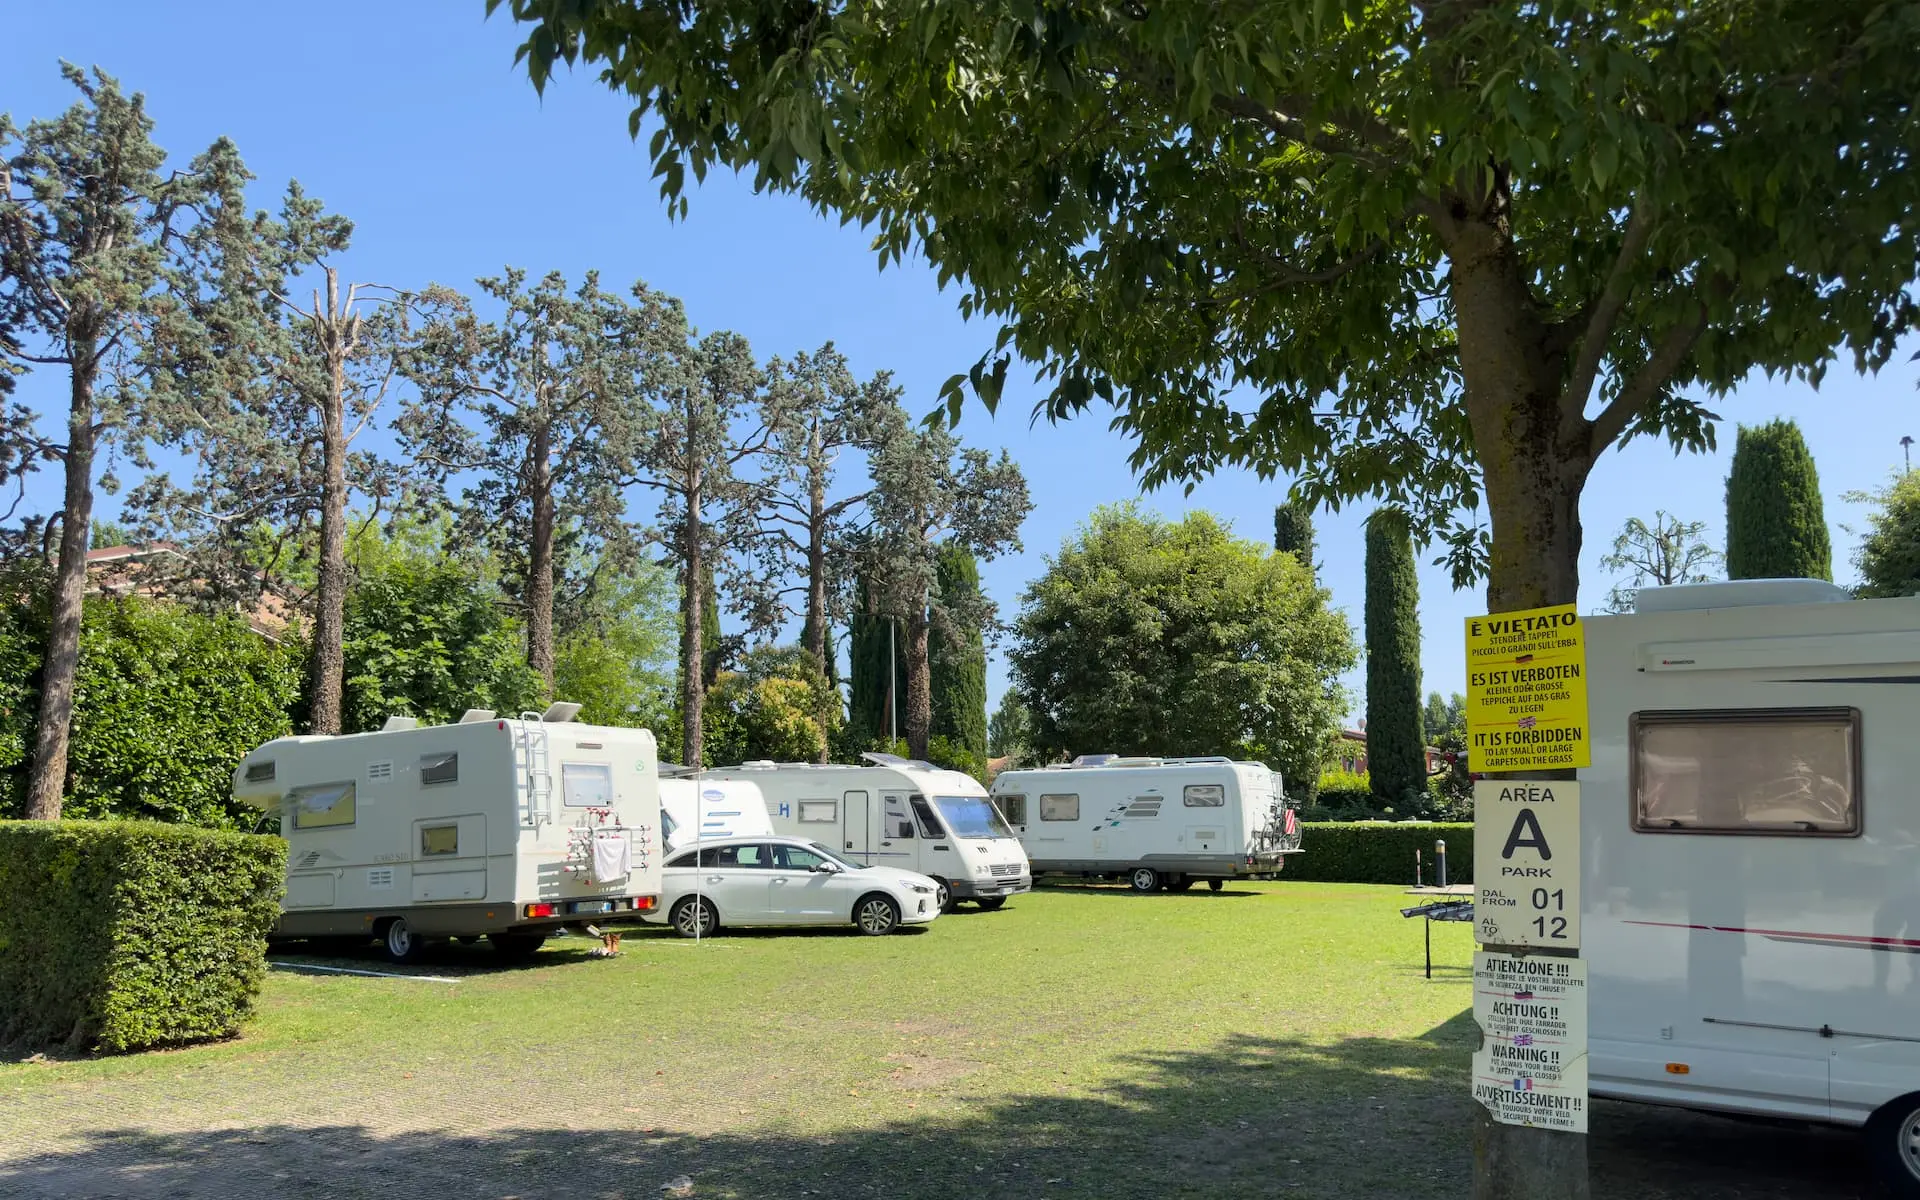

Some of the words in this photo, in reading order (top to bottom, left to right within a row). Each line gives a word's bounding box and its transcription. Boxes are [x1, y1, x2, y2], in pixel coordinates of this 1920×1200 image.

[1488, 612, 1576, 635] VIETATO
[1490, 634, 1526, 645] STENDERE
[1529, 631, 1557, 641] TAPPETI
[1472, 648, 1499, 656] PICCOLI
[1508, 644, 1536, 653] GRANDI
[1538, 639, 1576, 650] SULL'ERBA
[1472, 673, 1486, 686] ES
[1490, 671, 1508, 685] IST
[1512, 664, 1580, 683] VERBOTEN
[1486, 686, 1514, 696] KLEINE
[1514, 684, 1534, 693] ODER
[1536, 682, 1564, 691] GROSSE
[1482, 696, 1515, 706] TEPPICHE
[1518, 694, 1532, 703] AUF
[1534, 693, 1549, 702] DAS
[1550, 691, 1570, 700] GRAS
[1521, 704, 1544, 713] LEGEN
[1475, 734, 1486, 746] IT
[1490, 732, 1502, 745] IS
[1506, 728, 1582, 745] FORBIDDEN
[1485, 748, 1494, 757] TO
[1496, 748, 1508, 756] LAY
[1510, 745, 1535, 755] SMALL
[1549, 744, 1573, 752] LARGE
[1486, 758, 1518, 767] CARPETS
[1520, 757, 1530, 765] ON
[1533, 756, 1547, 764] THE
[1548, 755, 1573, 764] GRASS
[1500, 788, 1554, 802] AREA
[1502, 808, 1552, 861] A
[1502, 867, 1552, 878] PARK
[1482, 898, 1516, 907] FROM
[1532, 888, 1564, 910] 01
[1482, 926, 1498, 934] TO
[1532, 916, 1567, 939] 12
[1557, 964, 1569, 976] !!!
[1493, 1002, 1546, 1018] ACHTUNG
[1551, 1008, 1558, 1019] !!
[1492, 1044, 1547, 1062] WARNING
[1552, 1051, 1559, 1064] !!
[1535, 1072, 1557, 1080] CLOSED
[1476, 1084, 1570, 1109] AVVERTISSEMENT
[1574, 1097, 1581, 1111] !!
[1502, 1105, 1532, 1113] TOUJOURS
[1534, 1108, 1553, 1116] VOTRE
